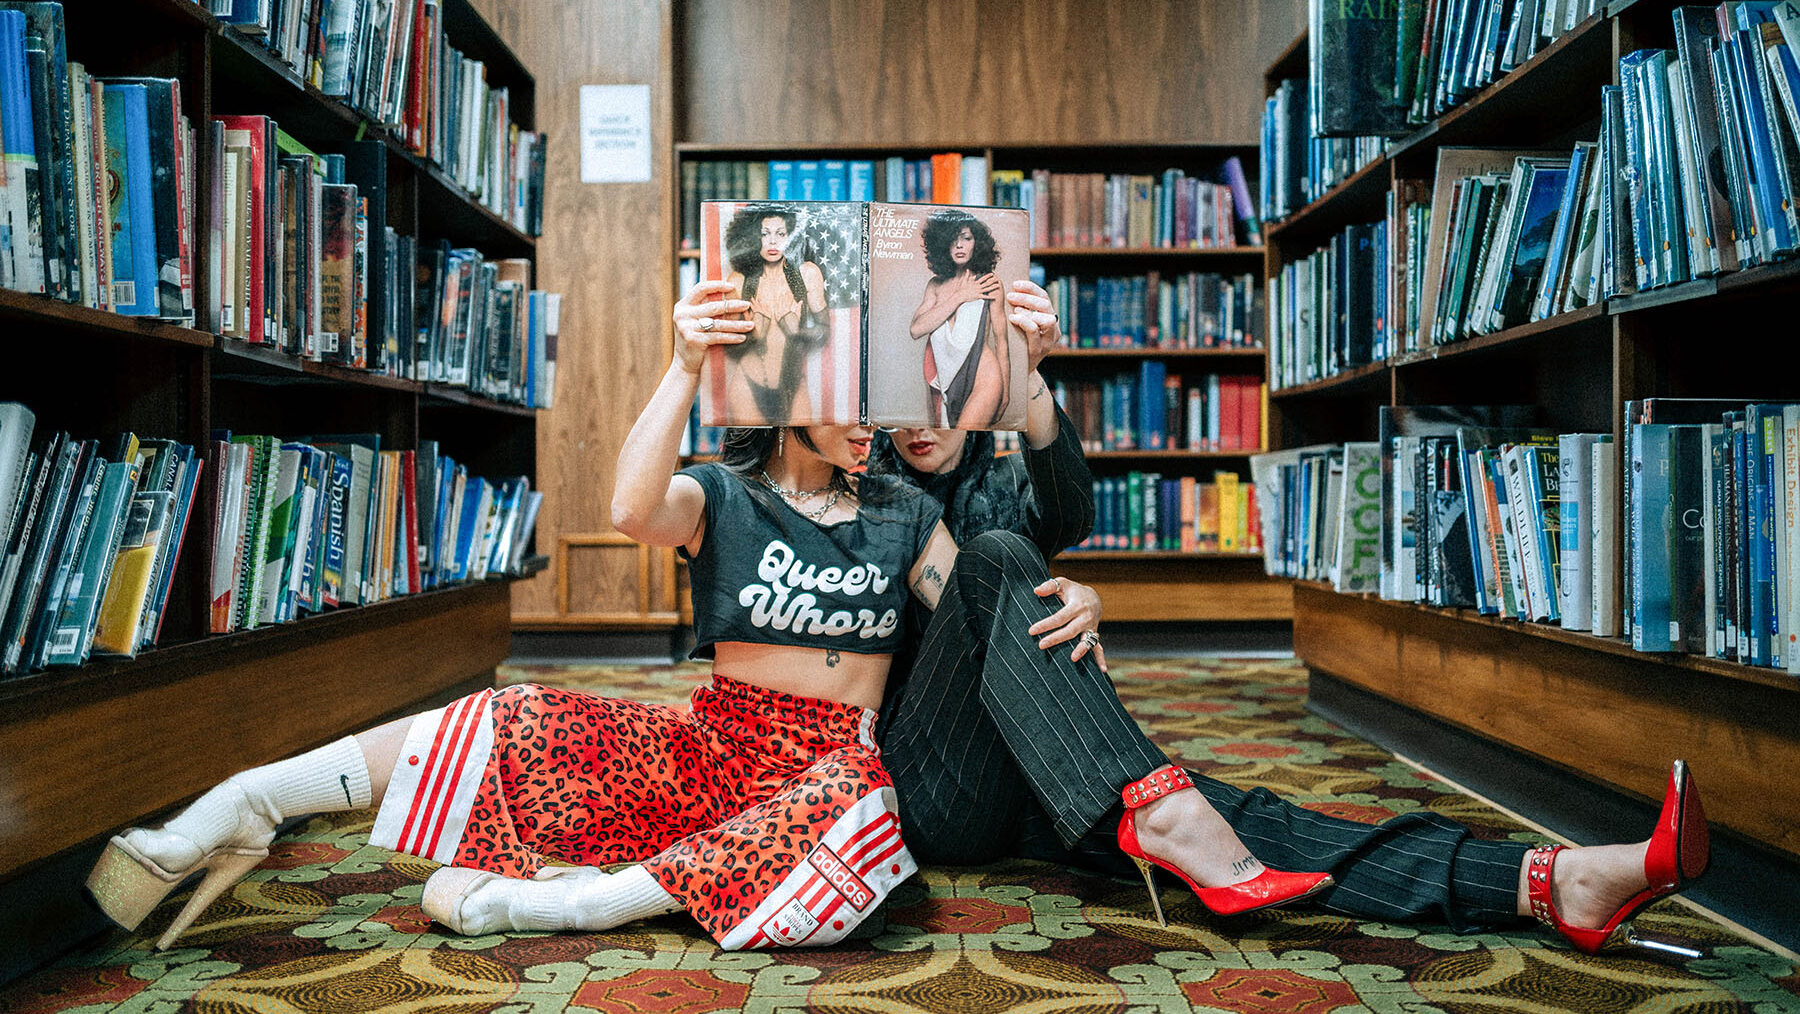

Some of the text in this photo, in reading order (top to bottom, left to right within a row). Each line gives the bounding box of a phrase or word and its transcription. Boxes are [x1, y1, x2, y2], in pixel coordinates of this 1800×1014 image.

[62, 76, 76, 241] THE DEPARTMENT STORE
[94, 162, 103, 214] BRITISH
[872, 219, 920, 230] ULTIMATE
[872, 228, 913, 239] ANGELS
[875, 207, 895, 219] THE
[98, 217, 106, 282] RAILWAYS
[872, 250, 914, 260] Newman
[875, 239, 903, 250] Byron
[1786, 427, 1796, 475] Exhibit
[1747, 458, 1755, 502] ORIGINS
[1787, 480, 1797, 528] Design
[21, 465, 48, 546] WARTIME GWR
[330, 472, 349, 560] Spanish
[147, 555, 160, 589] MAIN
[758, 539, 889, 596] Queer
[738, 583, 898, 639] Whore
[812, 850, 867, 907] adidas
[783, 913, 802, 935] STRIPES
[792, 903, 814, 927] BRAND
